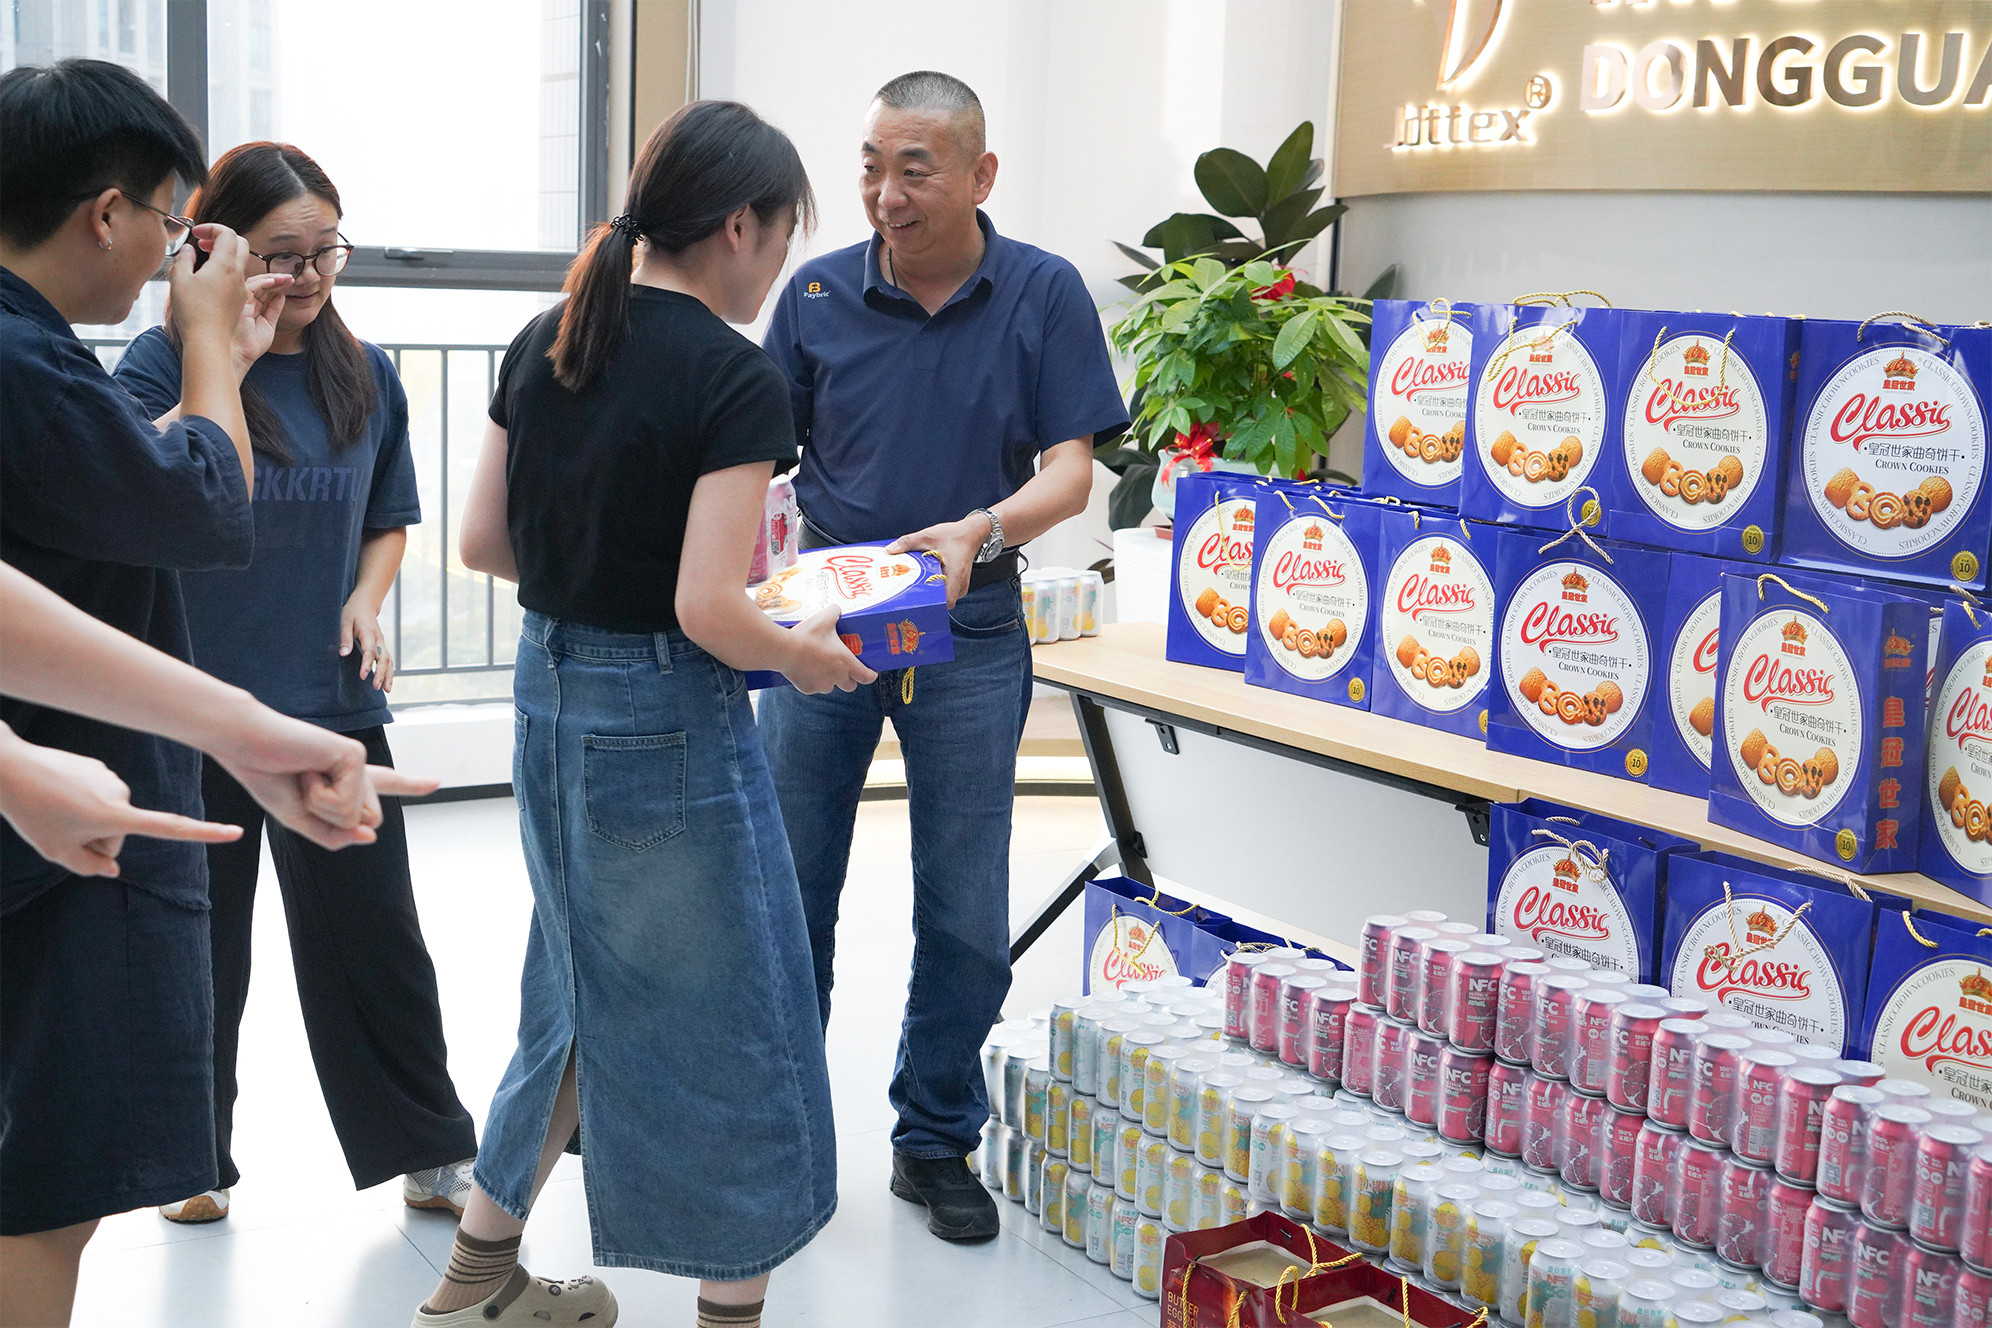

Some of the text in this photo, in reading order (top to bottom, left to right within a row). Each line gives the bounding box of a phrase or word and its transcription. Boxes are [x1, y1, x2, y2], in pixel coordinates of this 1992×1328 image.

[1392, 356, 1470, 402] Classic
[1493, 366, 1581, 415] Classic
[1645, 378, 1741, 432] Classic
[1527, 422, 1581, 434] CROWN COOKIES
[1830, 392, 1953, 454] Classic
[1682, 439, 1741, 454] CROWN COOKIES
[1867, 441, 1960, 463] 皇冠世家曲奇饼干
[1874, 458, 1949, 475] CROWN COOKIES
[1273, 550, 1346, 597] Classic
[1397, 573, 1475, 623] Classic
[1428, 629, 1477, 647] CROWN COOKIES
[1520, 601, 1621, 655] Classic
[1551, 645, 1629, 669] 皇冠世家曲奇饼干
[1558, 661, 1620, 681] CROWN COOKIES
[1743, 653, 1836, 716] Classic
[1773, 704, 1844, 736] 皇冠世家曲奇饼干
[1779, 722, 1837, 748] CROWN COOKIES
[1874, 695, 1907, 850] 皇冠世家
[1514, 885, 1610, 944] Classic
[1544, 936, 1620, 971] 皇冠世家曲奇饼干
[1468, 978, 1498, 992] NFC
[1315, 1010, 1340, 1026] NFC
[1733, 996, 1821, 1034] 皇冠世家曲奇饼干
[1412, 1051, 1438, 1068] NFC
[1669, 1048, 1691, 1063] NF
[1446, 1067, 1472, 1084] NFC
[1753, 1080, 1774, 1092] NFC
[1502, 1082, 1522, 1096] NF
[1950, 1086, 1988, 1109] CROWN
[1124, 1138, 1138, 1148] NF
[1822, 1226, 1846, 1244] NF
[1858, 1241, 1890, 1265] NFC
[1916, 1268, 1953, 1289] NFC
[1167, 1291, 1200, 1316] BUTER
[1167, 1304, 1183, 1322] EGG
